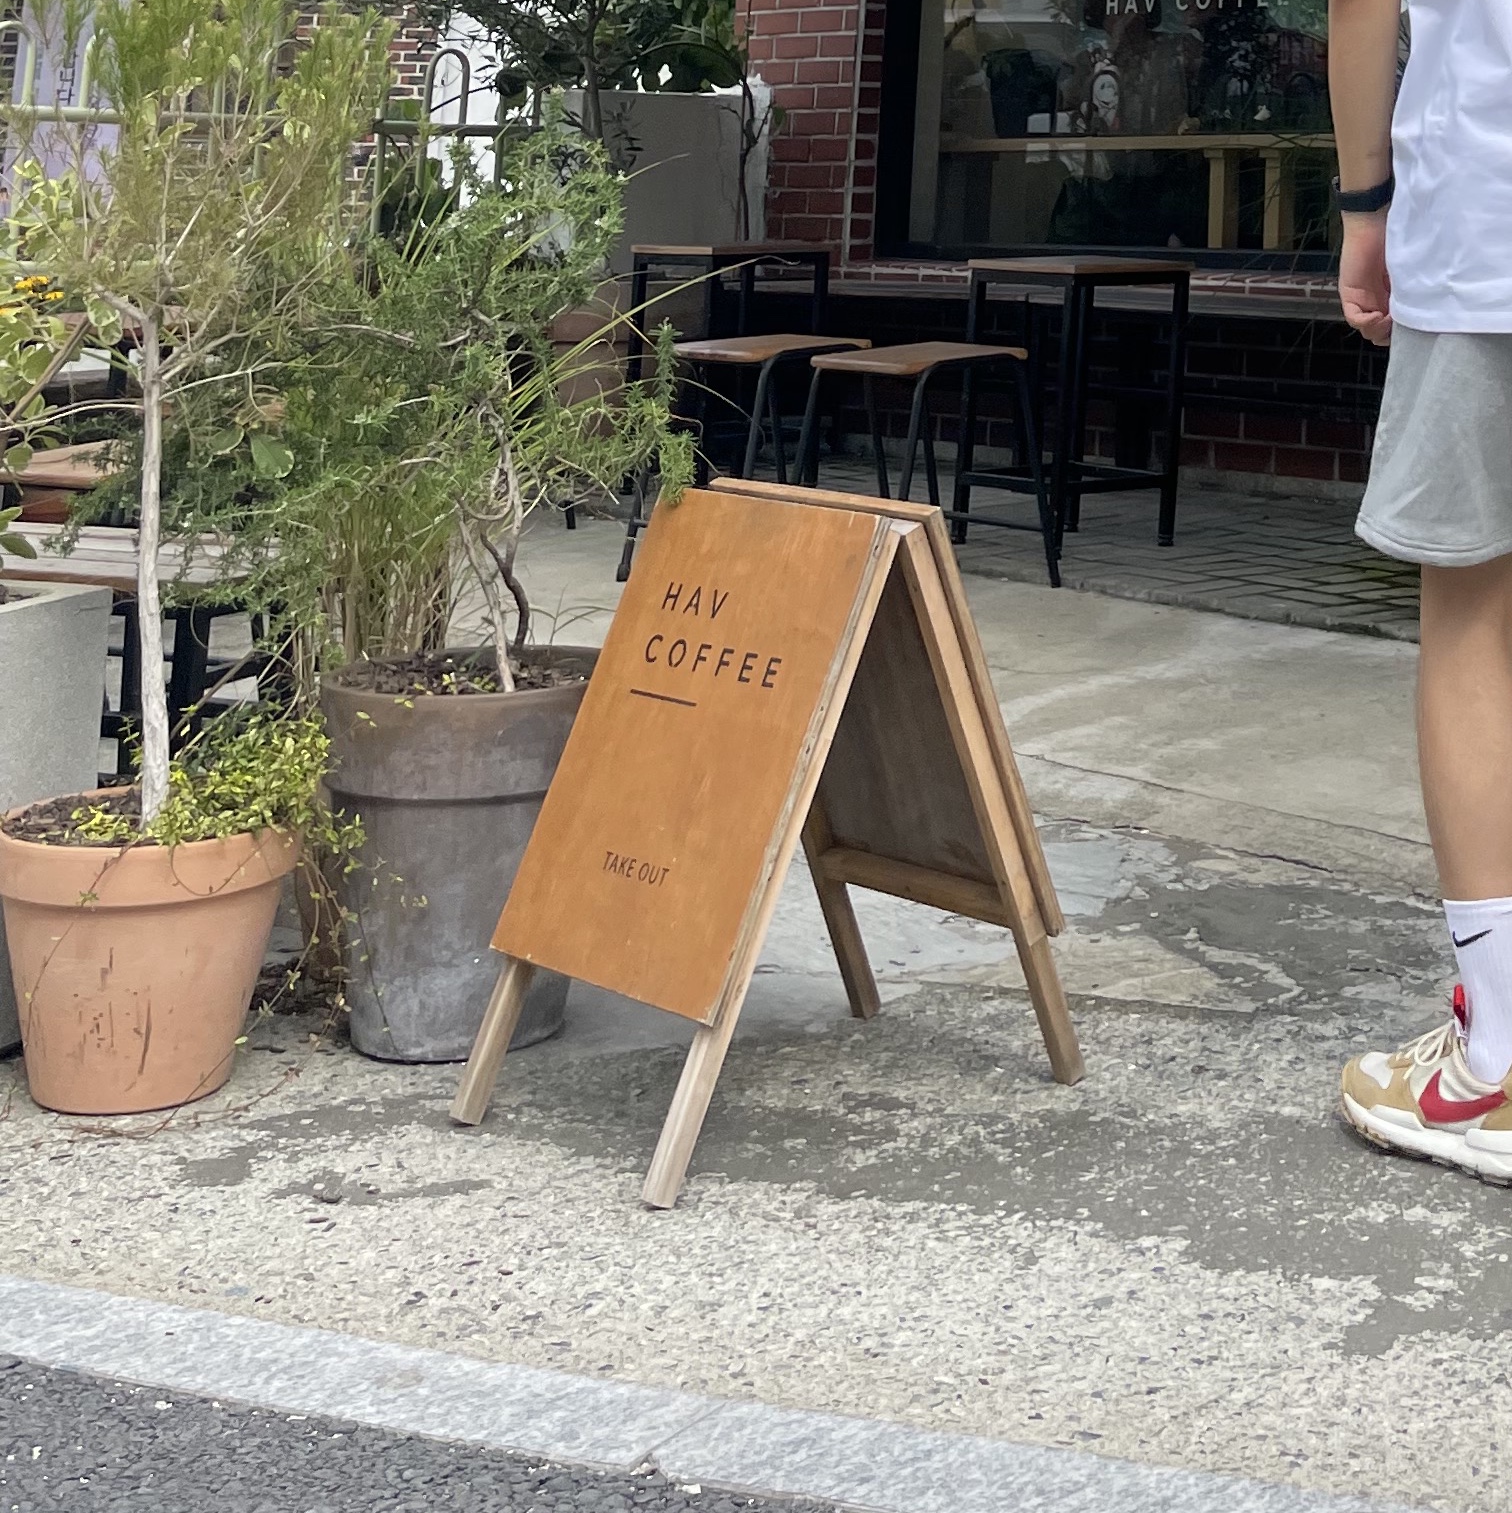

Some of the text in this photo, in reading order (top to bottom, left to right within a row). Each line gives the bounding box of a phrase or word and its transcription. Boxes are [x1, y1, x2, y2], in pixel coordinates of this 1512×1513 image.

[661, 581, 729, 620] HAV
[644, 633, 783, 689] COFFEE
[602, 850, 670, 887] TAKE OUT
